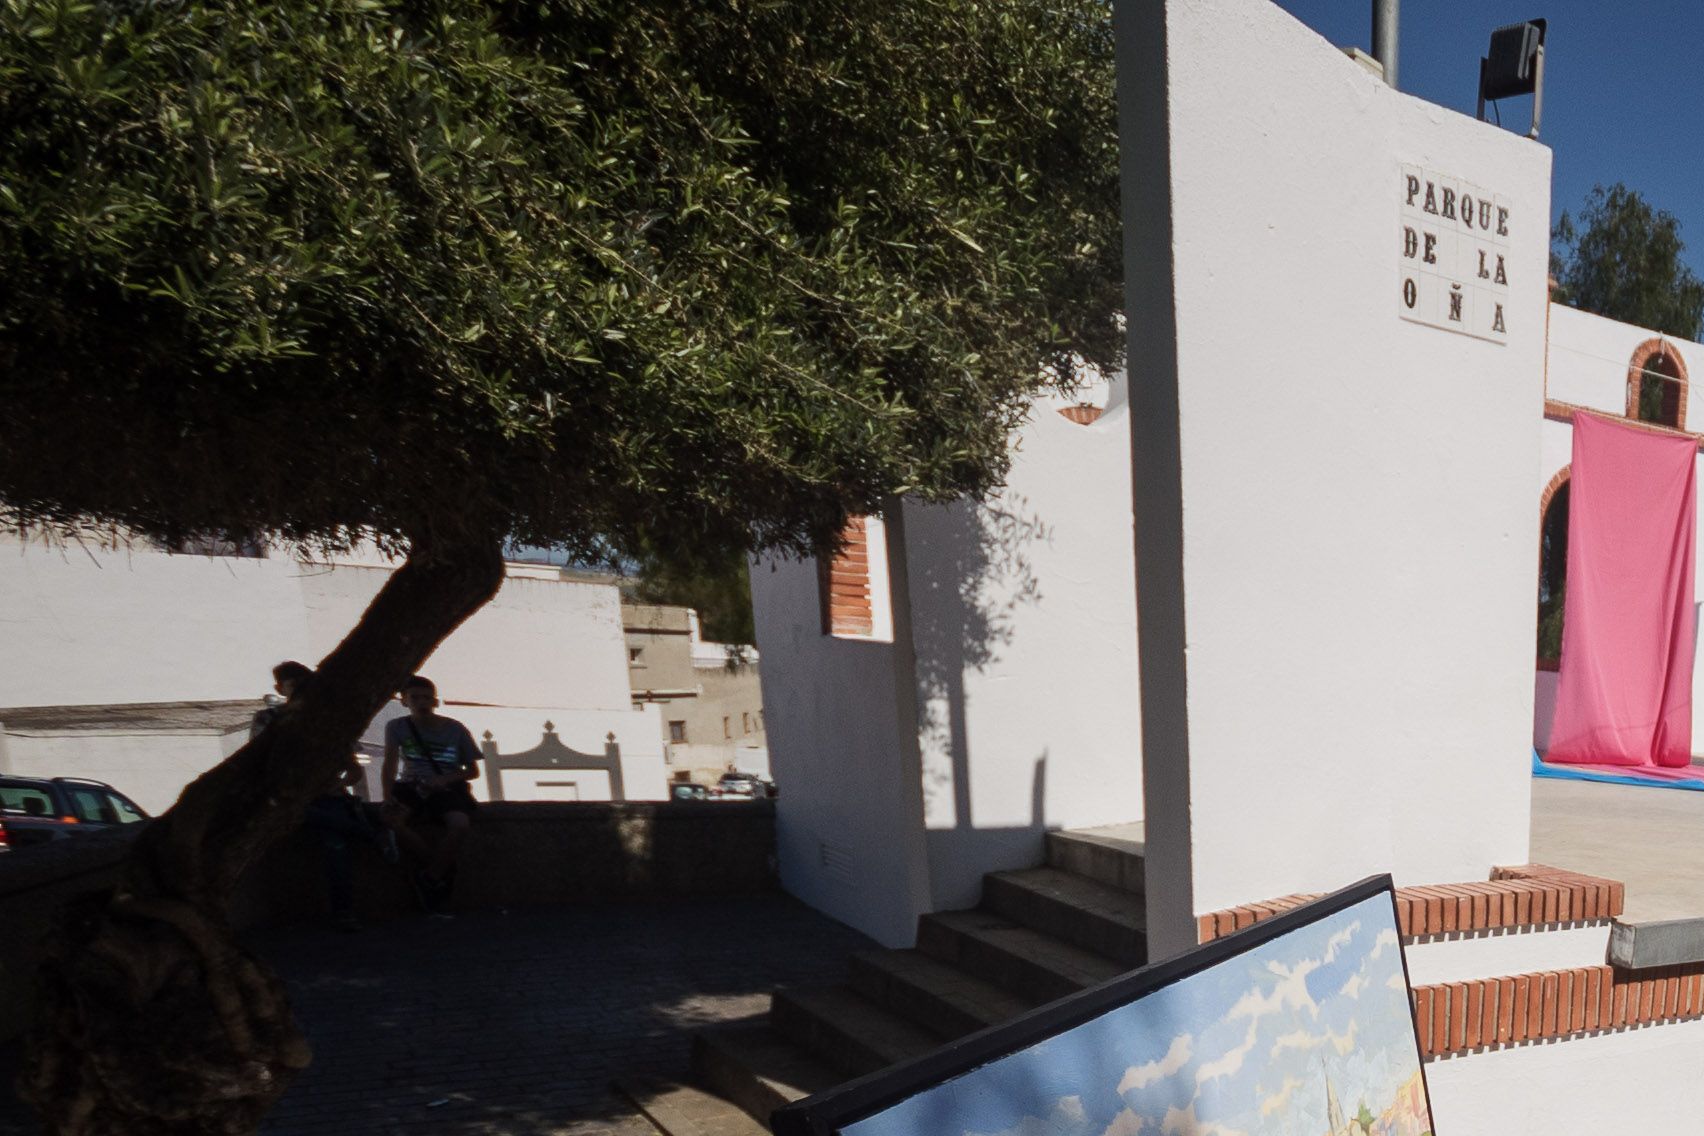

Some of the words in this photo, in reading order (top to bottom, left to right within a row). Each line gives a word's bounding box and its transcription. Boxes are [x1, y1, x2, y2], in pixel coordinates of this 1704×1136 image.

[1406, 174, 1509, 236] PARQUE
[1403, 225, 1437, 264] DE
[1477, 249, 1508, 286] LA
